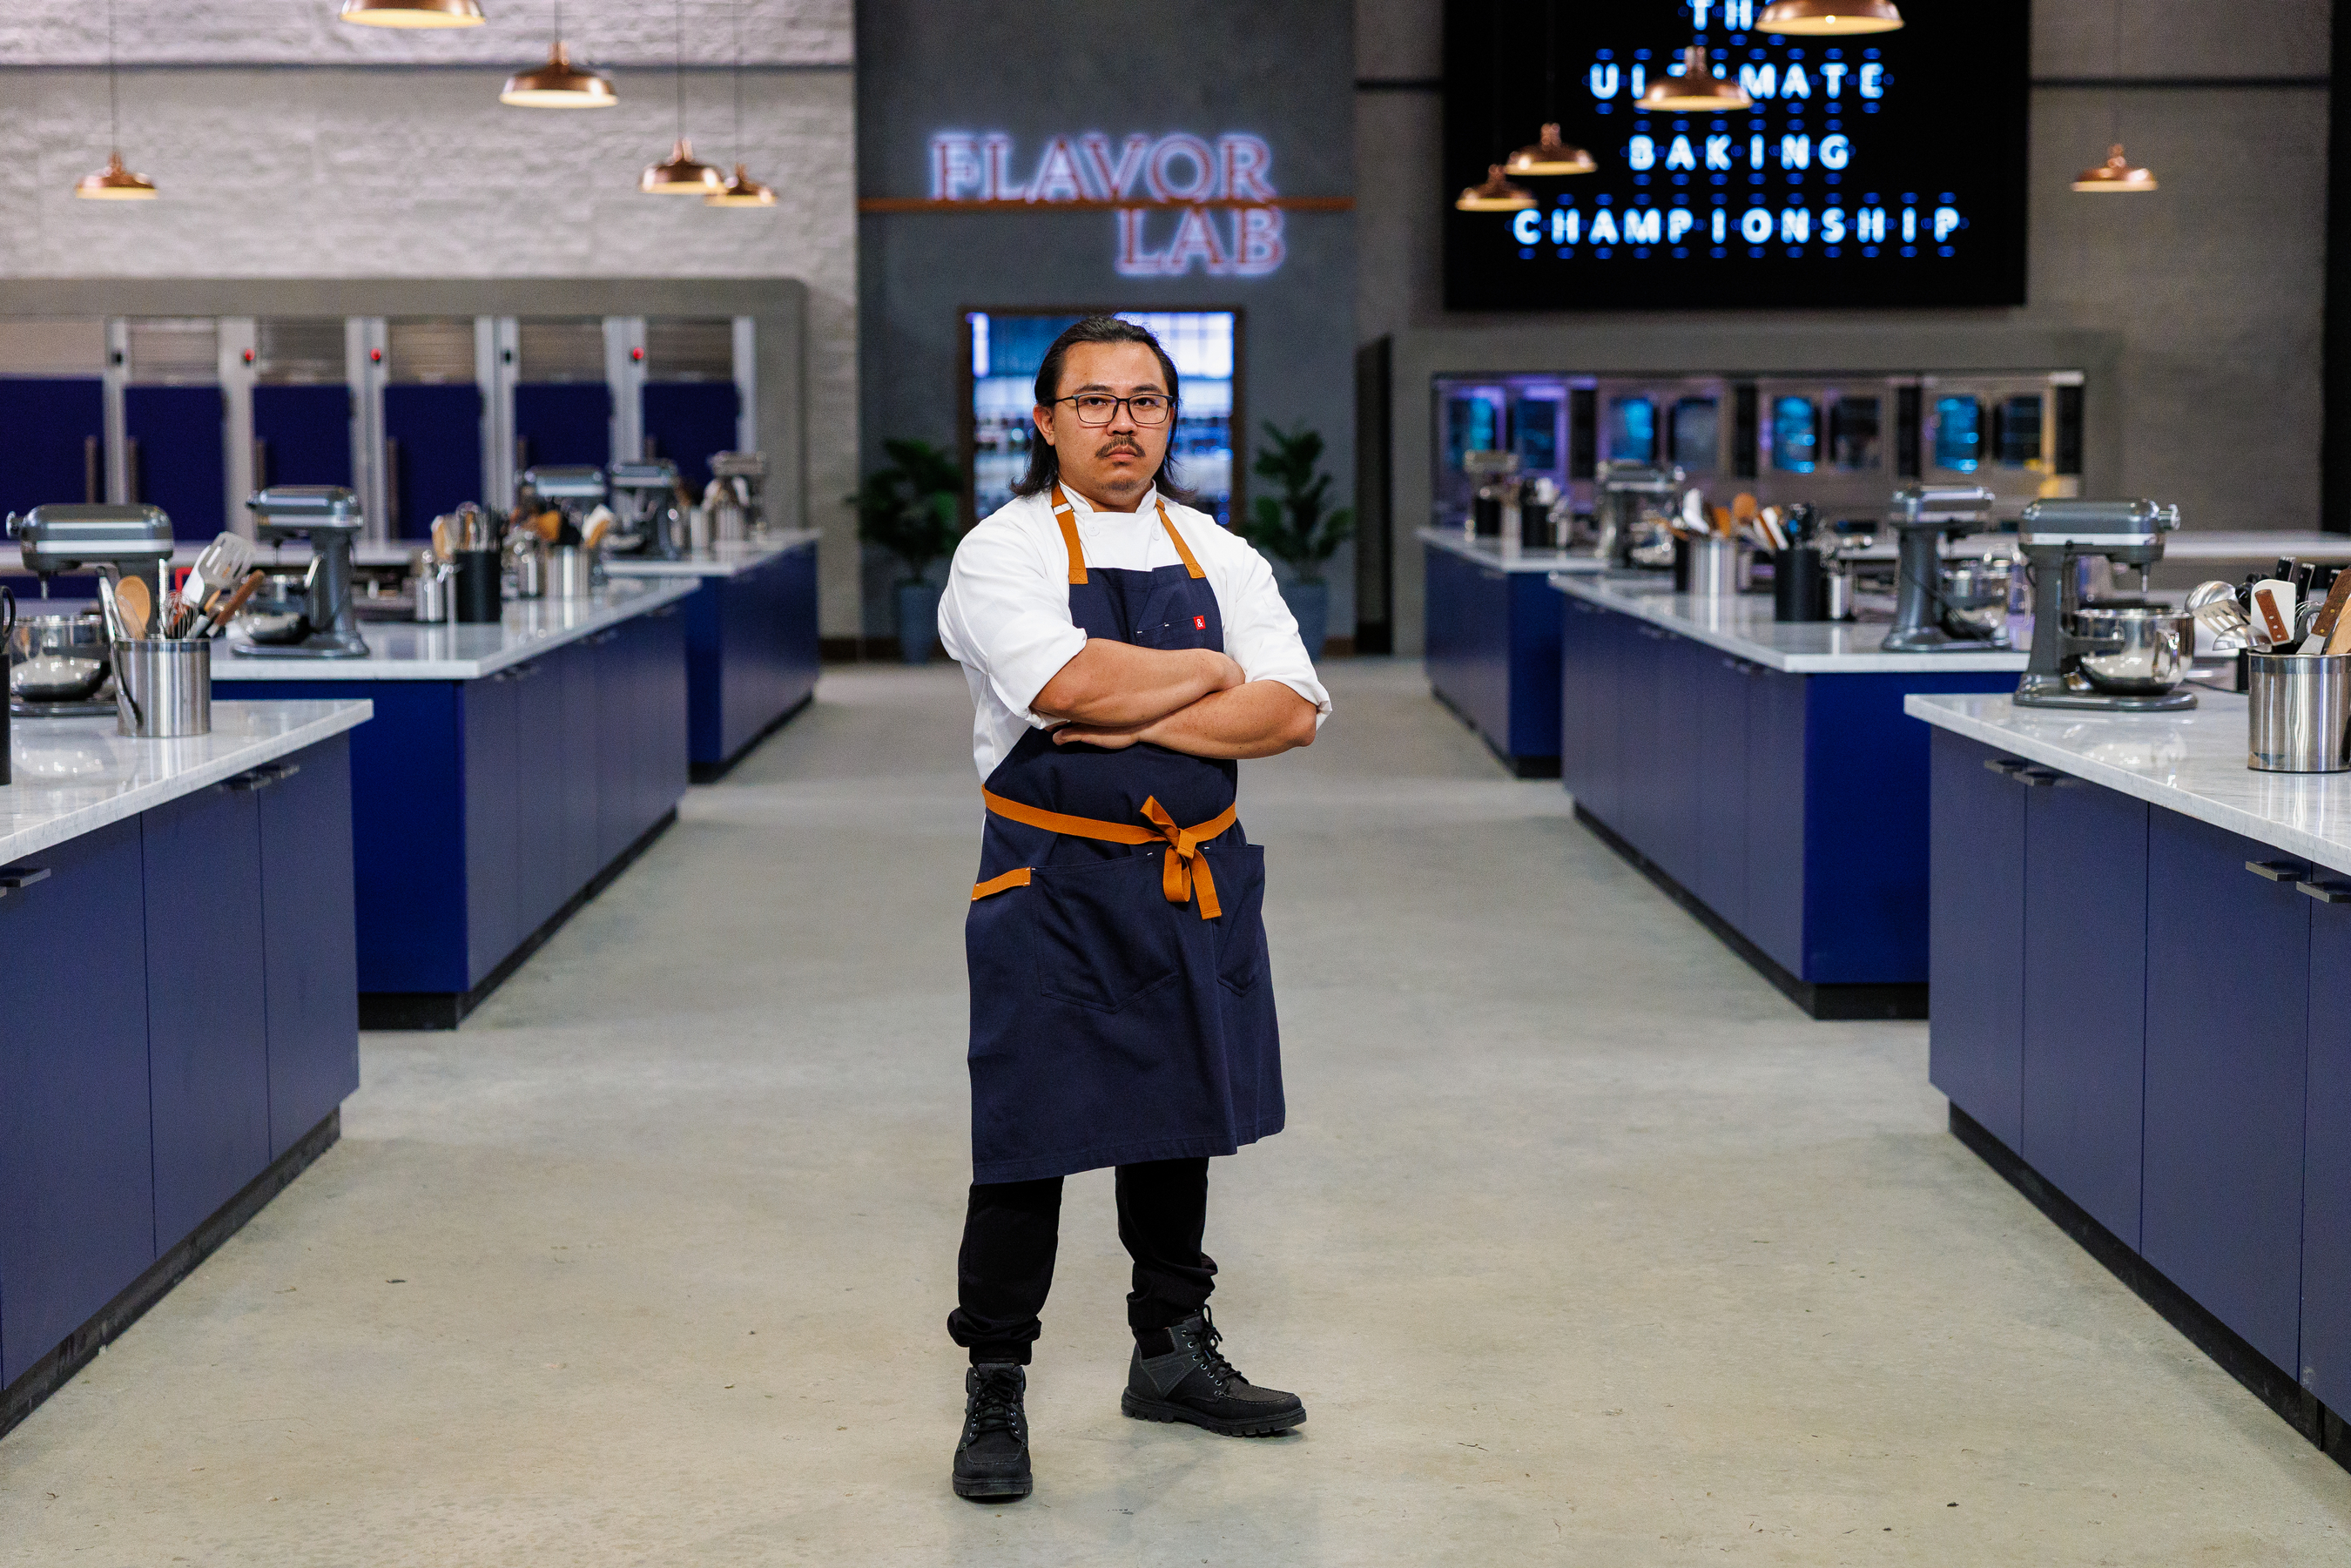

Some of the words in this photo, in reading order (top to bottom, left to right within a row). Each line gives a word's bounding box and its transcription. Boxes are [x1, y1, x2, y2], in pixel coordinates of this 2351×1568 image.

[1686, 0, 1780, 31] TH
[1589, 63, 1883, 99] ULMATE
[932, 132, 1277, 203] FLAVOR
[1628, 134, 1849, 171] BAKING
[1115, 207, 1285, 274] LAB
[1512, 207, 1960, 245] CHAMPIONSHIP
